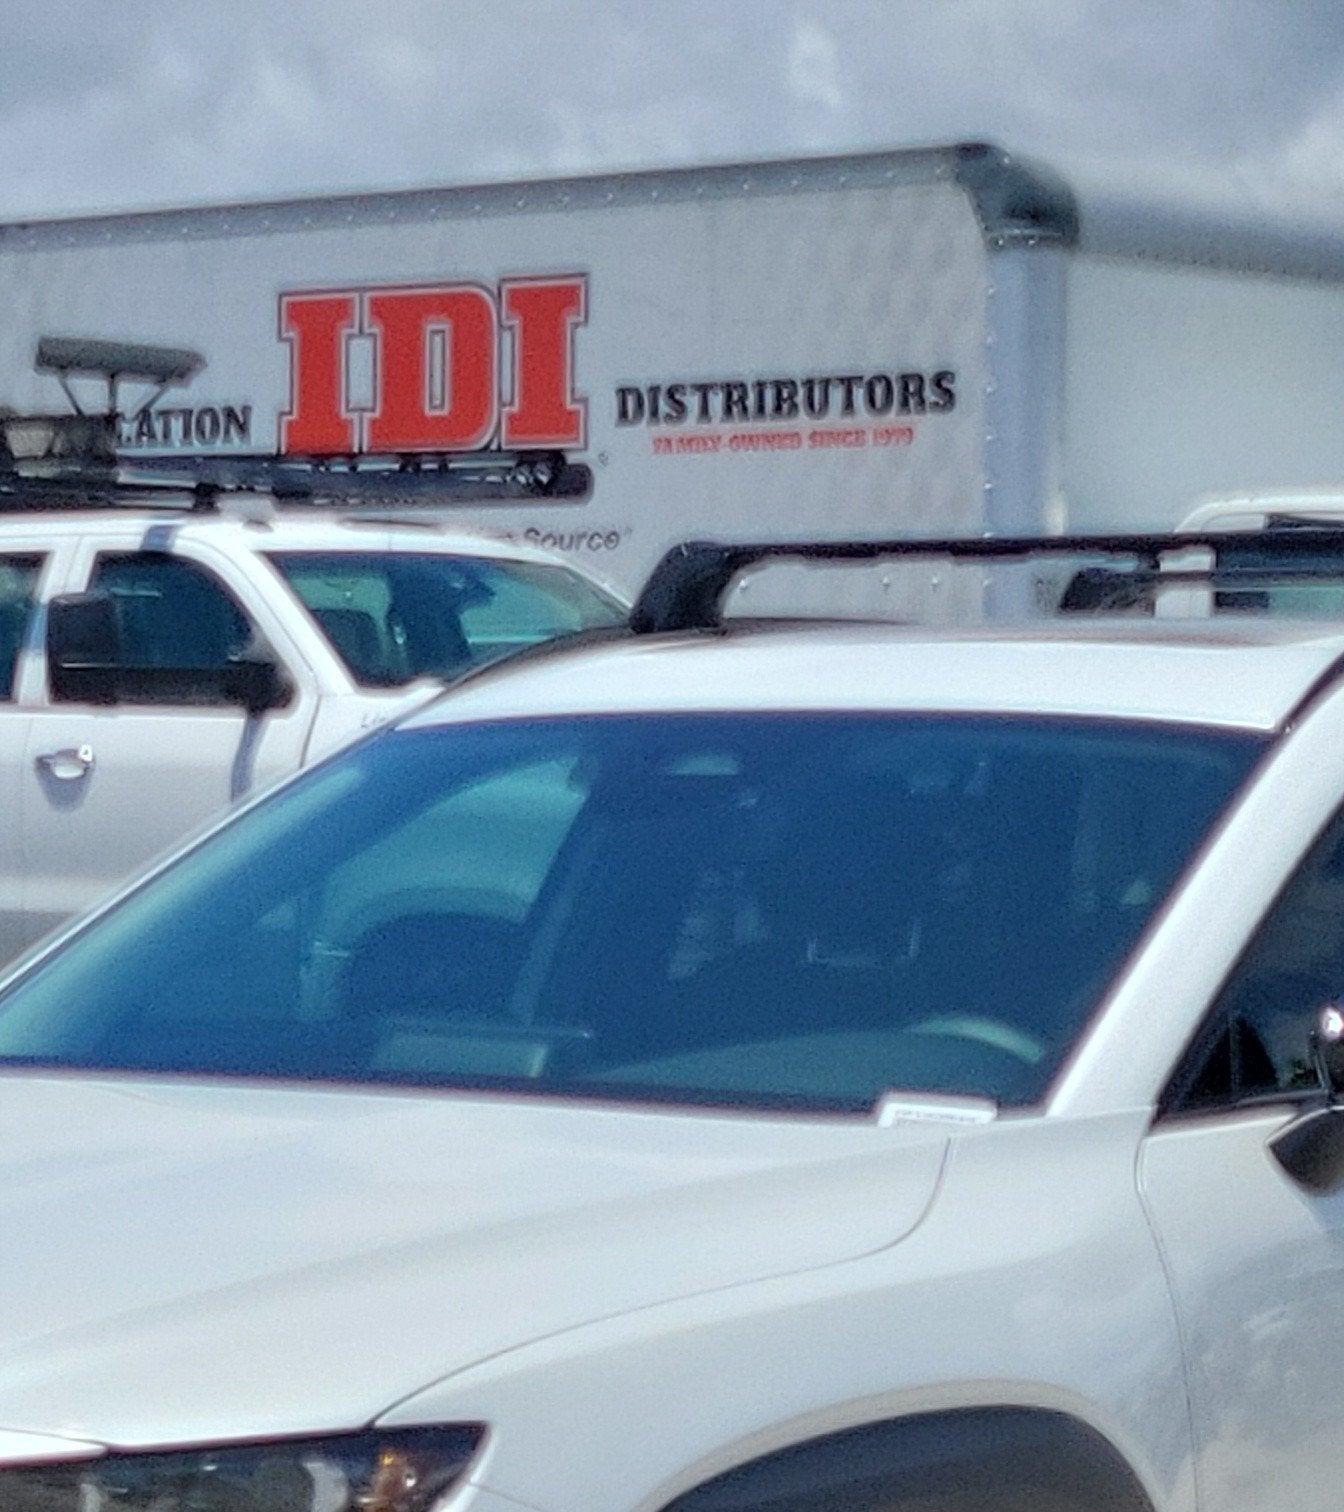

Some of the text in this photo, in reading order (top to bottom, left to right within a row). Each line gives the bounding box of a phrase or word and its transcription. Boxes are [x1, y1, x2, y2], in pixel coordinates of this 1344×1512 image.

[277, 272, 589, 453] IDI
[614, 370, 957, 427] DISTRIBUTORS
[808, 428, 866, 449] SINCE
[524, 525, 620, 551] Source
